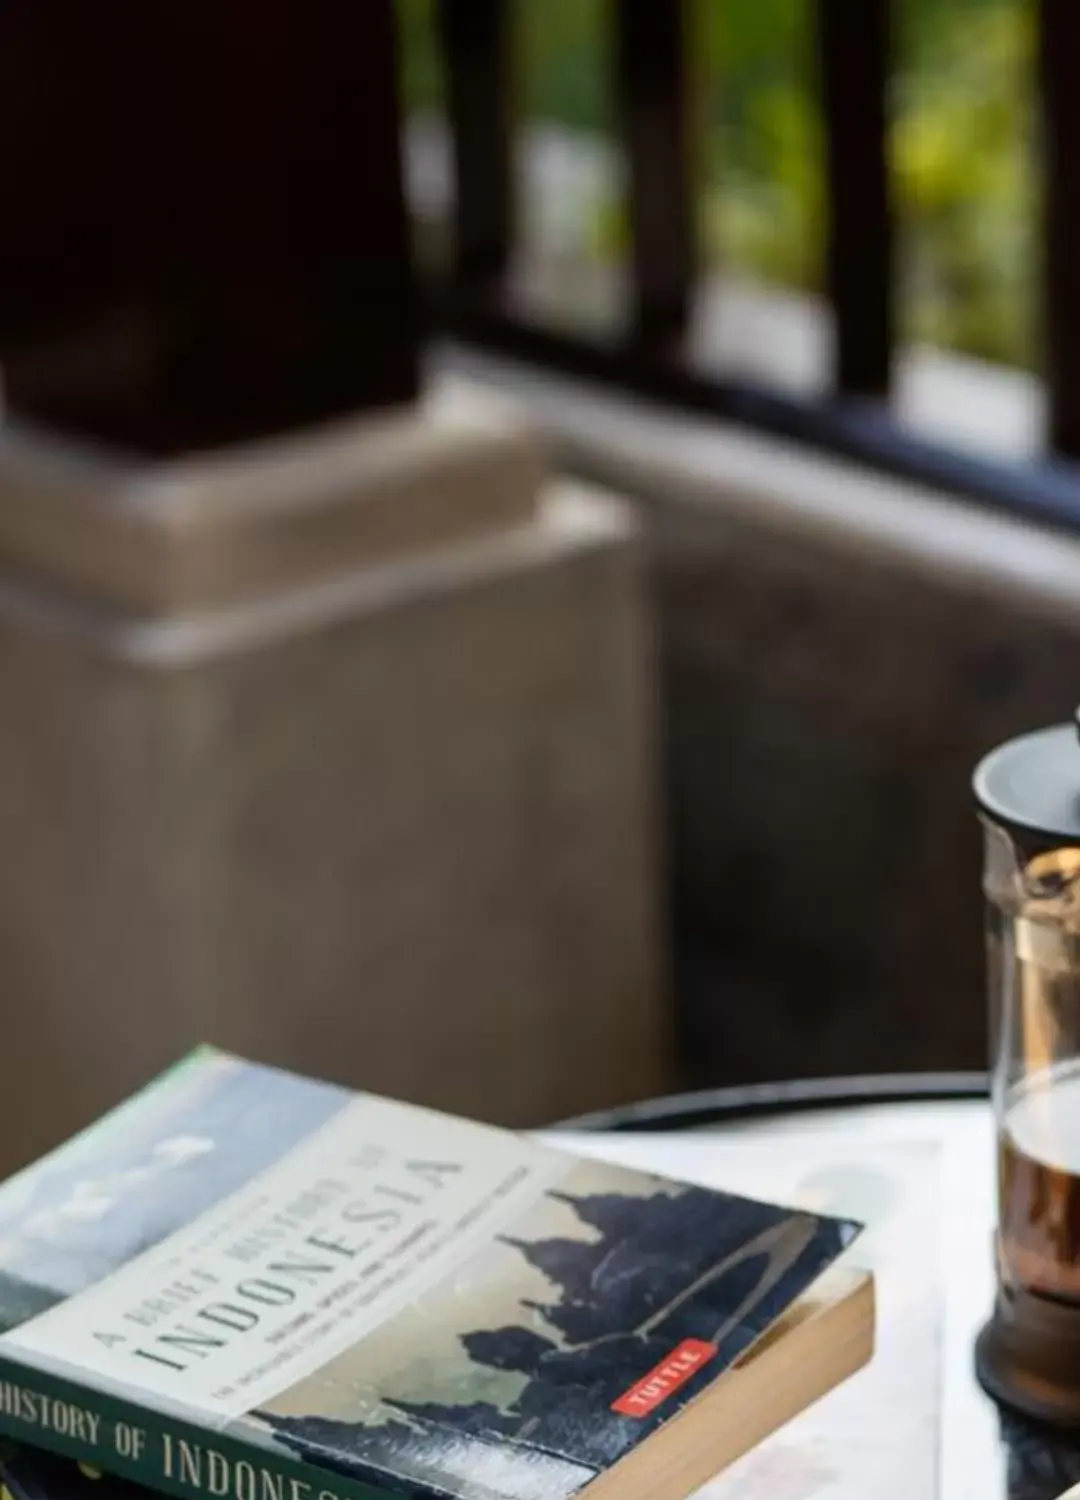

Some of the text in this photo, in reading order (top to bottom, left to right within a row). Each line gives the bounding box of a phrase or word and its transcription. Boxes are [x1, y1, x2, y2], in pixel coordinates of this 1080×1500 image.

[133, 1159, 463, 1371] INDONESIA
[627, 1350, 703, 1405] TUTTLE
[0, 1379, 101, 1446] HISTORY
[114, 1421, 147, 1461] OF
